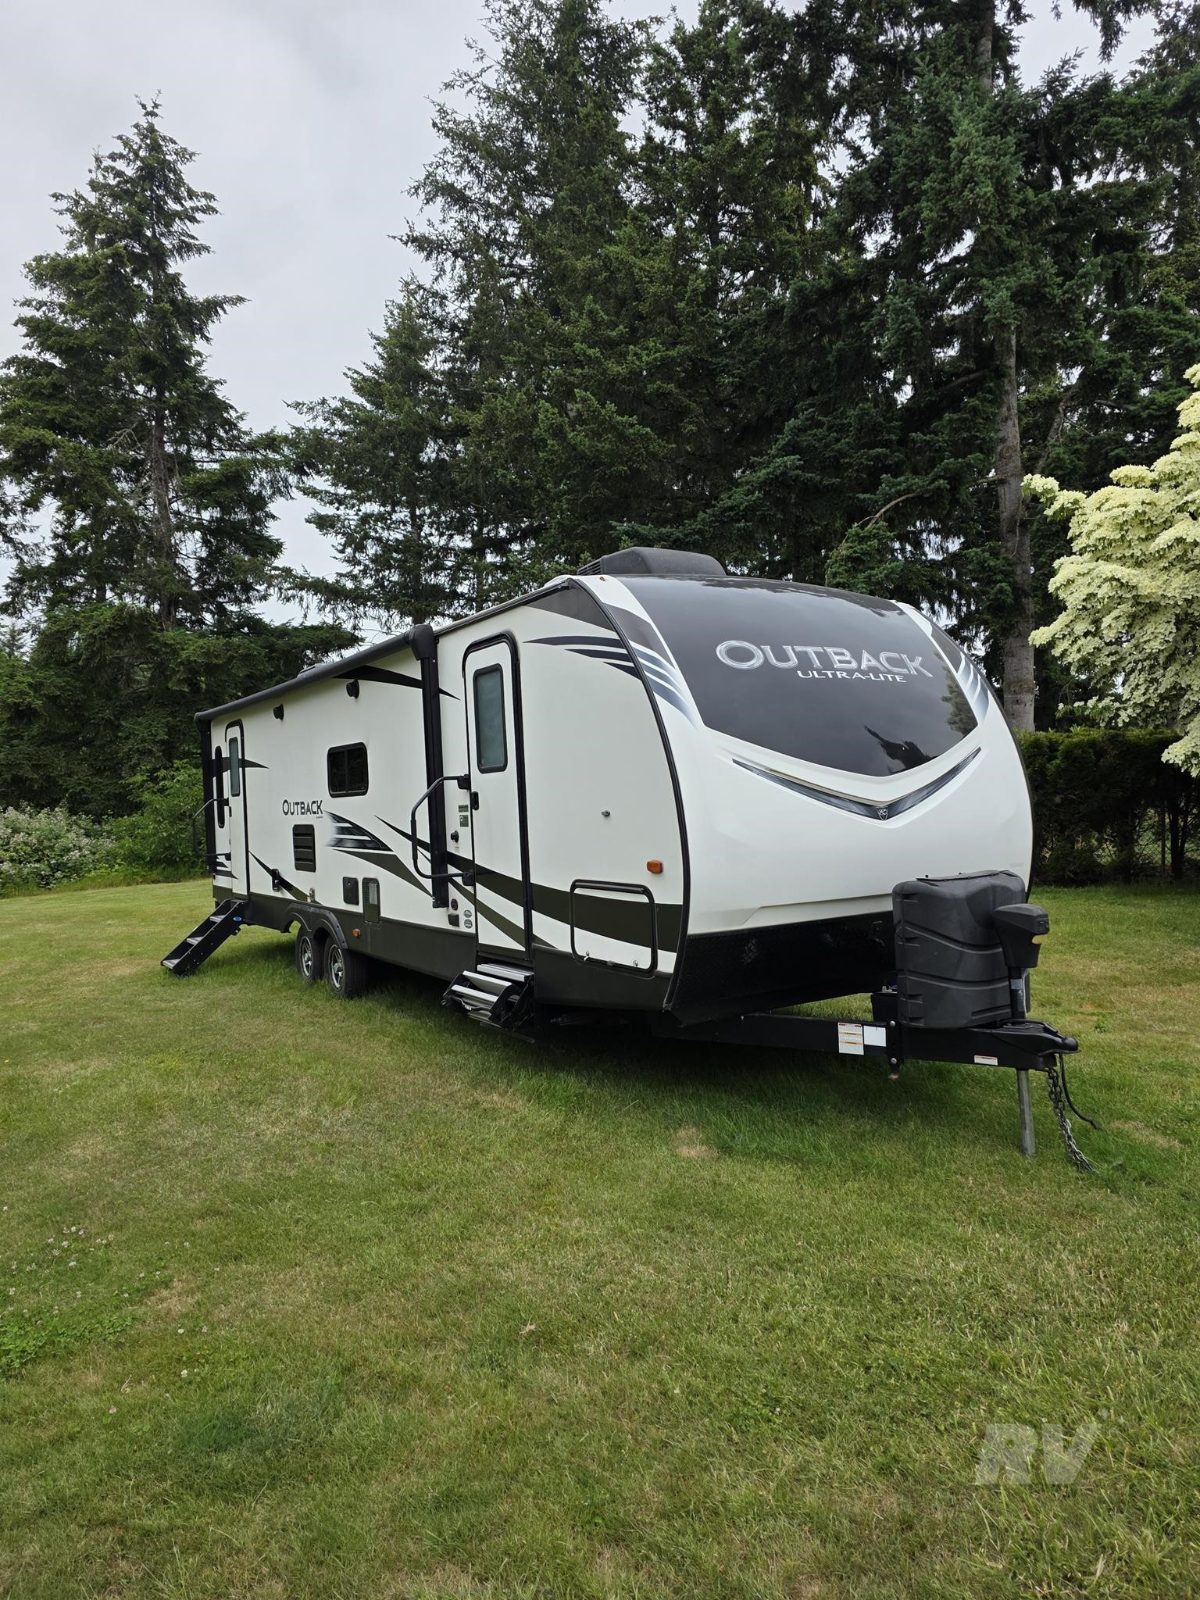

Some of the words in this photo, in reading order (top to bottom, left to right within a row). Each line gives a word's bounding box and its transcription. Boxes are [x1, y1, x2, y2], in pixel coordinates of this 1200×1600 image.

[715, 640, 933, 677] OUTBACK
[797, 670, 908, 683] ULTRA-LITE
[282, 799, 323, 816] OUTBACK
